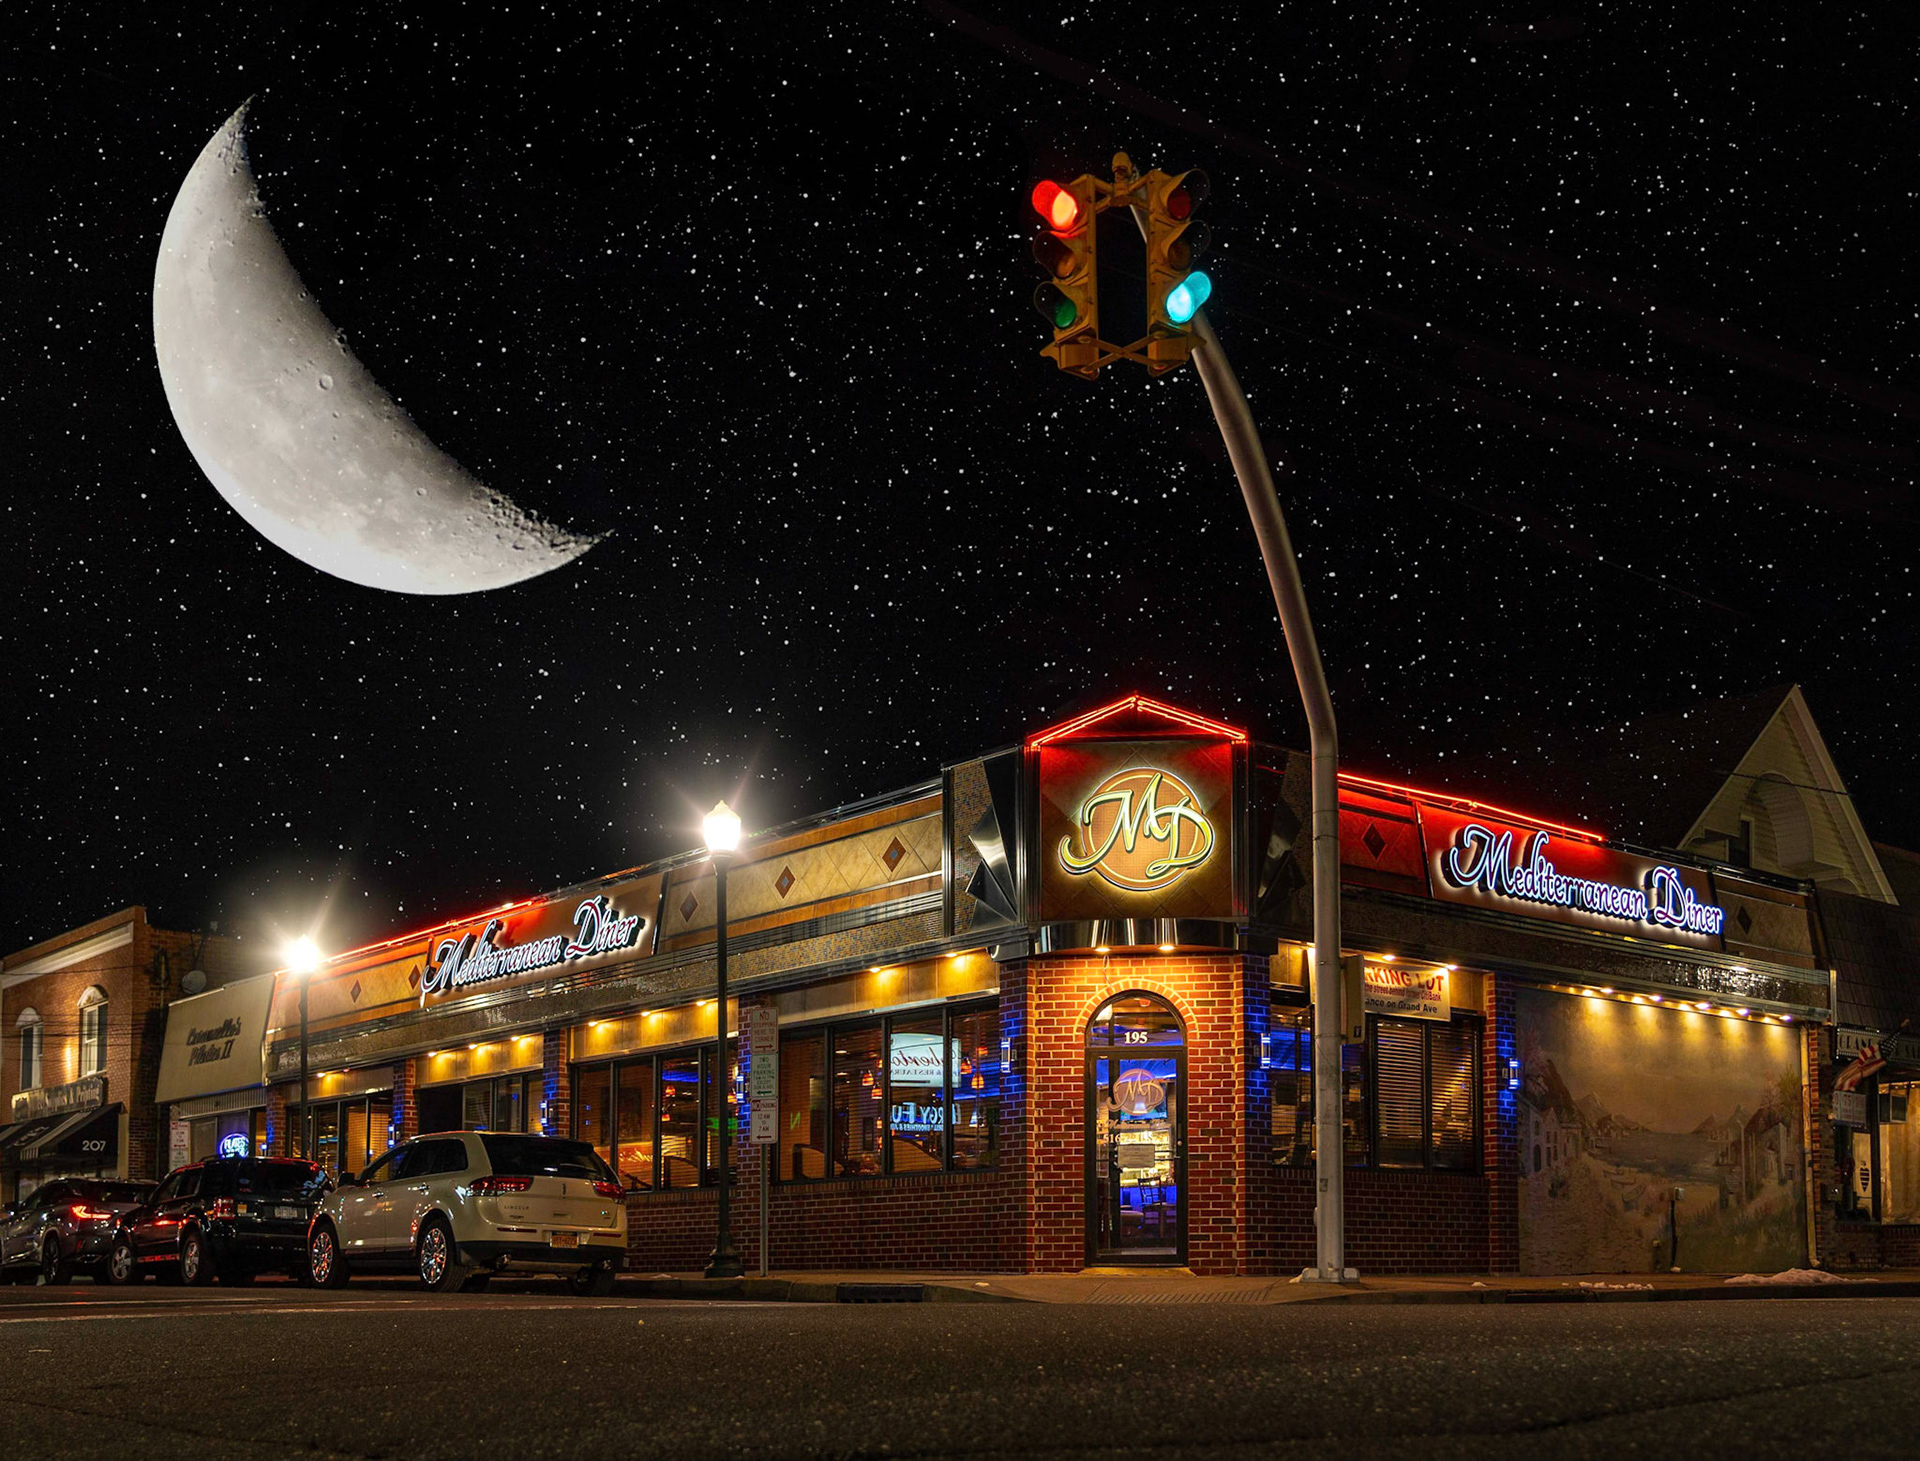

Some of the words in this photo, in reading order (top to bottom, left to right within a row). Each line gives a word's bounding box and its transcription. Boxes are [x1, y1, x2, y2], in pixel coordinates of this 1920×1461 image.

[1061, 773, 1213, 879] MD
[1451, 824, 1647, 919] Mediterranean
[1652, 866, 1723, 934] Diner
[421, 919, 563, 993] Mediterranean
[565, 895, 640, 960] Diner
[1415, 973, 1444, 991] LOT
[1387, 1000, 1396, 1008] on
[1398, 1001, 1420, 1011] Grand
[1423, 1004, 1438, 1013] Ave
[760, 1012, 769, 1020] NO
[1124, 1031, 1148, 1044] 195
[82, 1140, 106, 1151] 207
